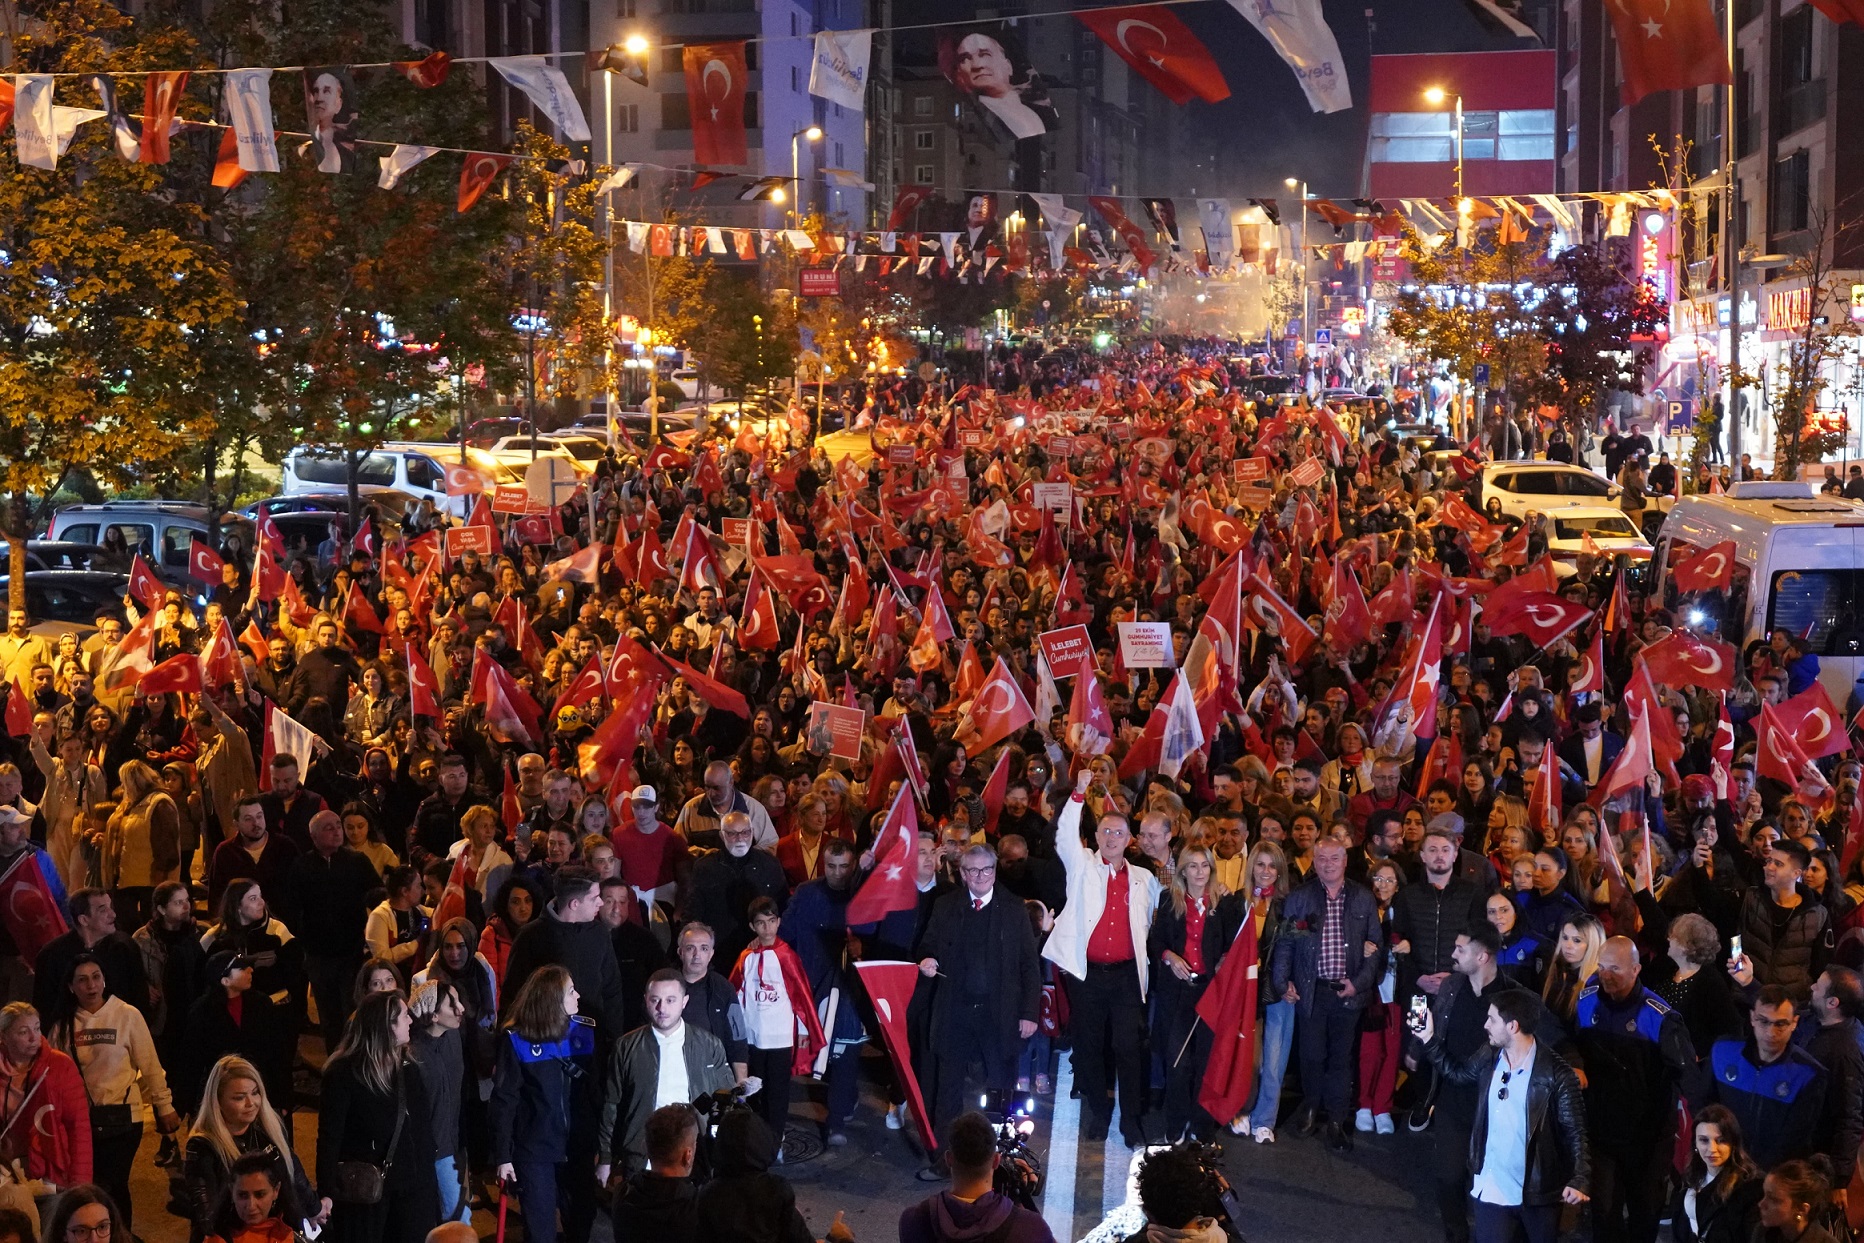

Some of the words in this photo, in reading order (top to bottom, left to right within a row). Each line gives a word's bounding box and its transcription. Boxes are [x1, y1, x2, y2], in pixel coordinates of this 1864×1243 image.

[1476, 365, 1484, 377] P
[1669, 402, 1683, 420] P
[1050, 638, 1082, 651] İLELEBET
